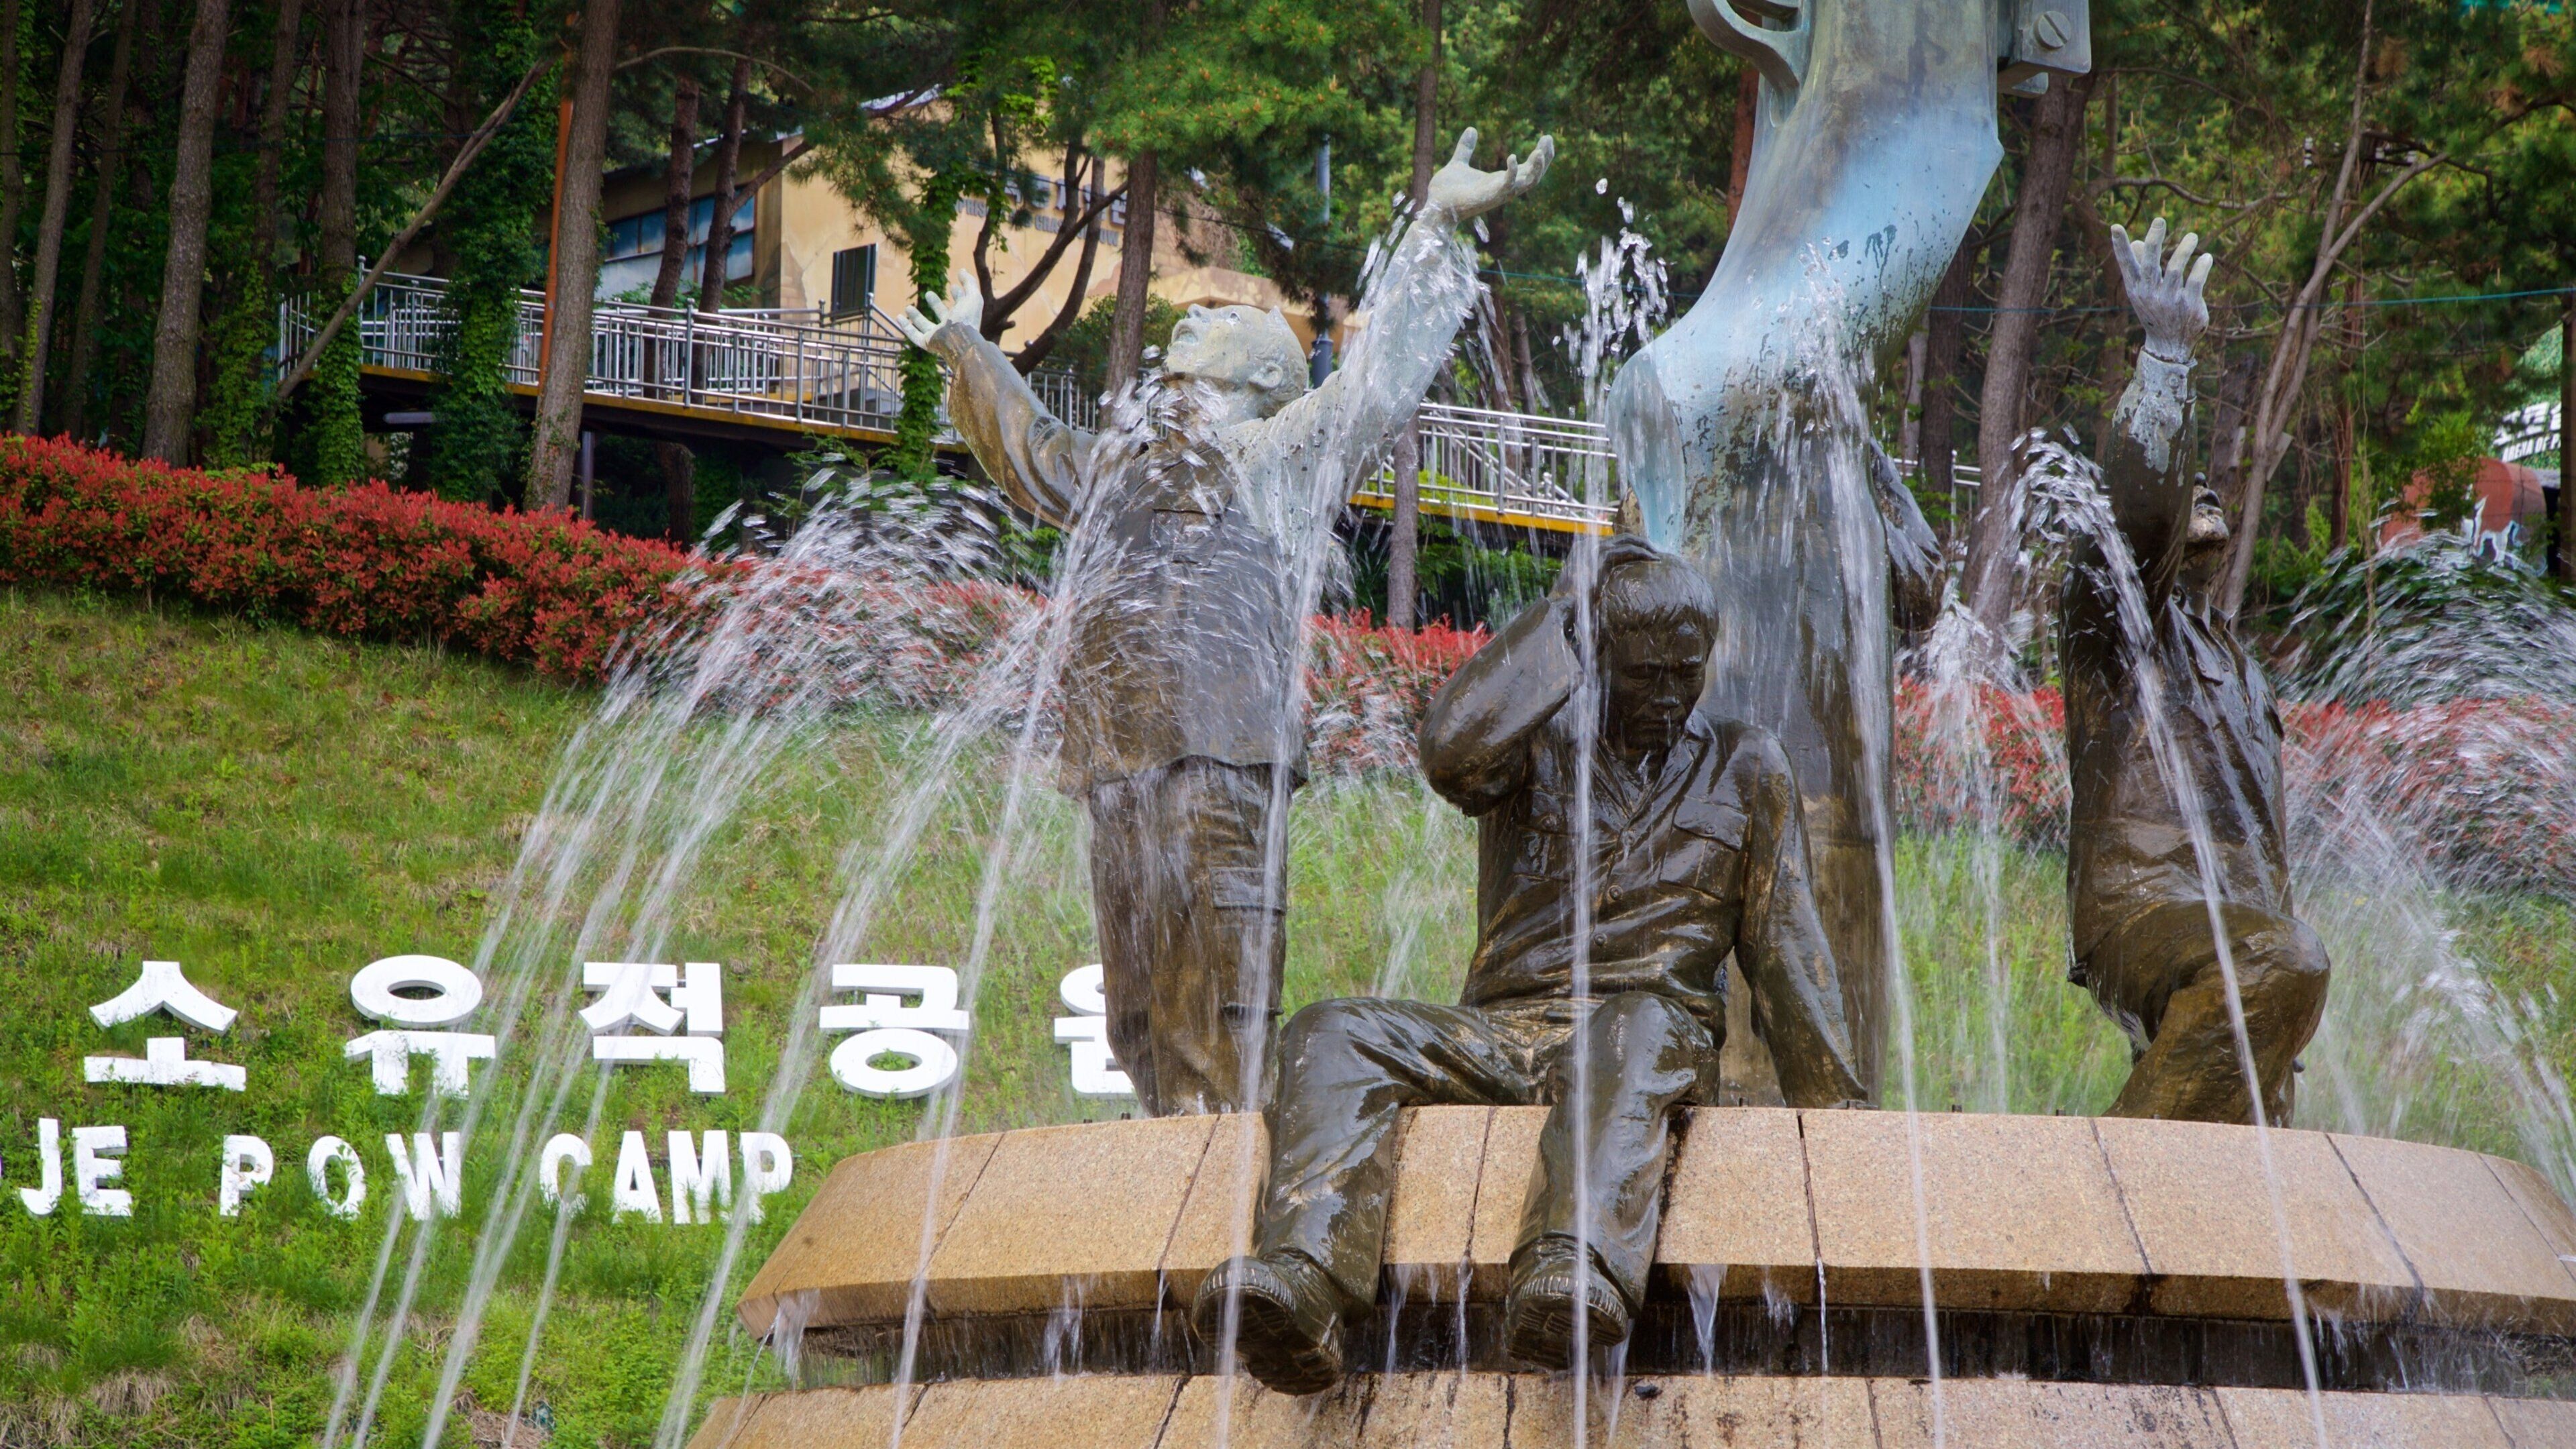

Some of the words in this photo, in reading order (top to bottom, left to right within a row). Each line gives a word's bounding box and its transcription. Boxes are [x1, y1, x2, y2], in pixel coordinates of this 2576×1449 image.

[2501, 438, 2534, 463] ARENA
[0, 1117, 132, 1218] JE
[219, 1131, 462, 1222] POW
[538, 1130, 793, 1225] CAMP
